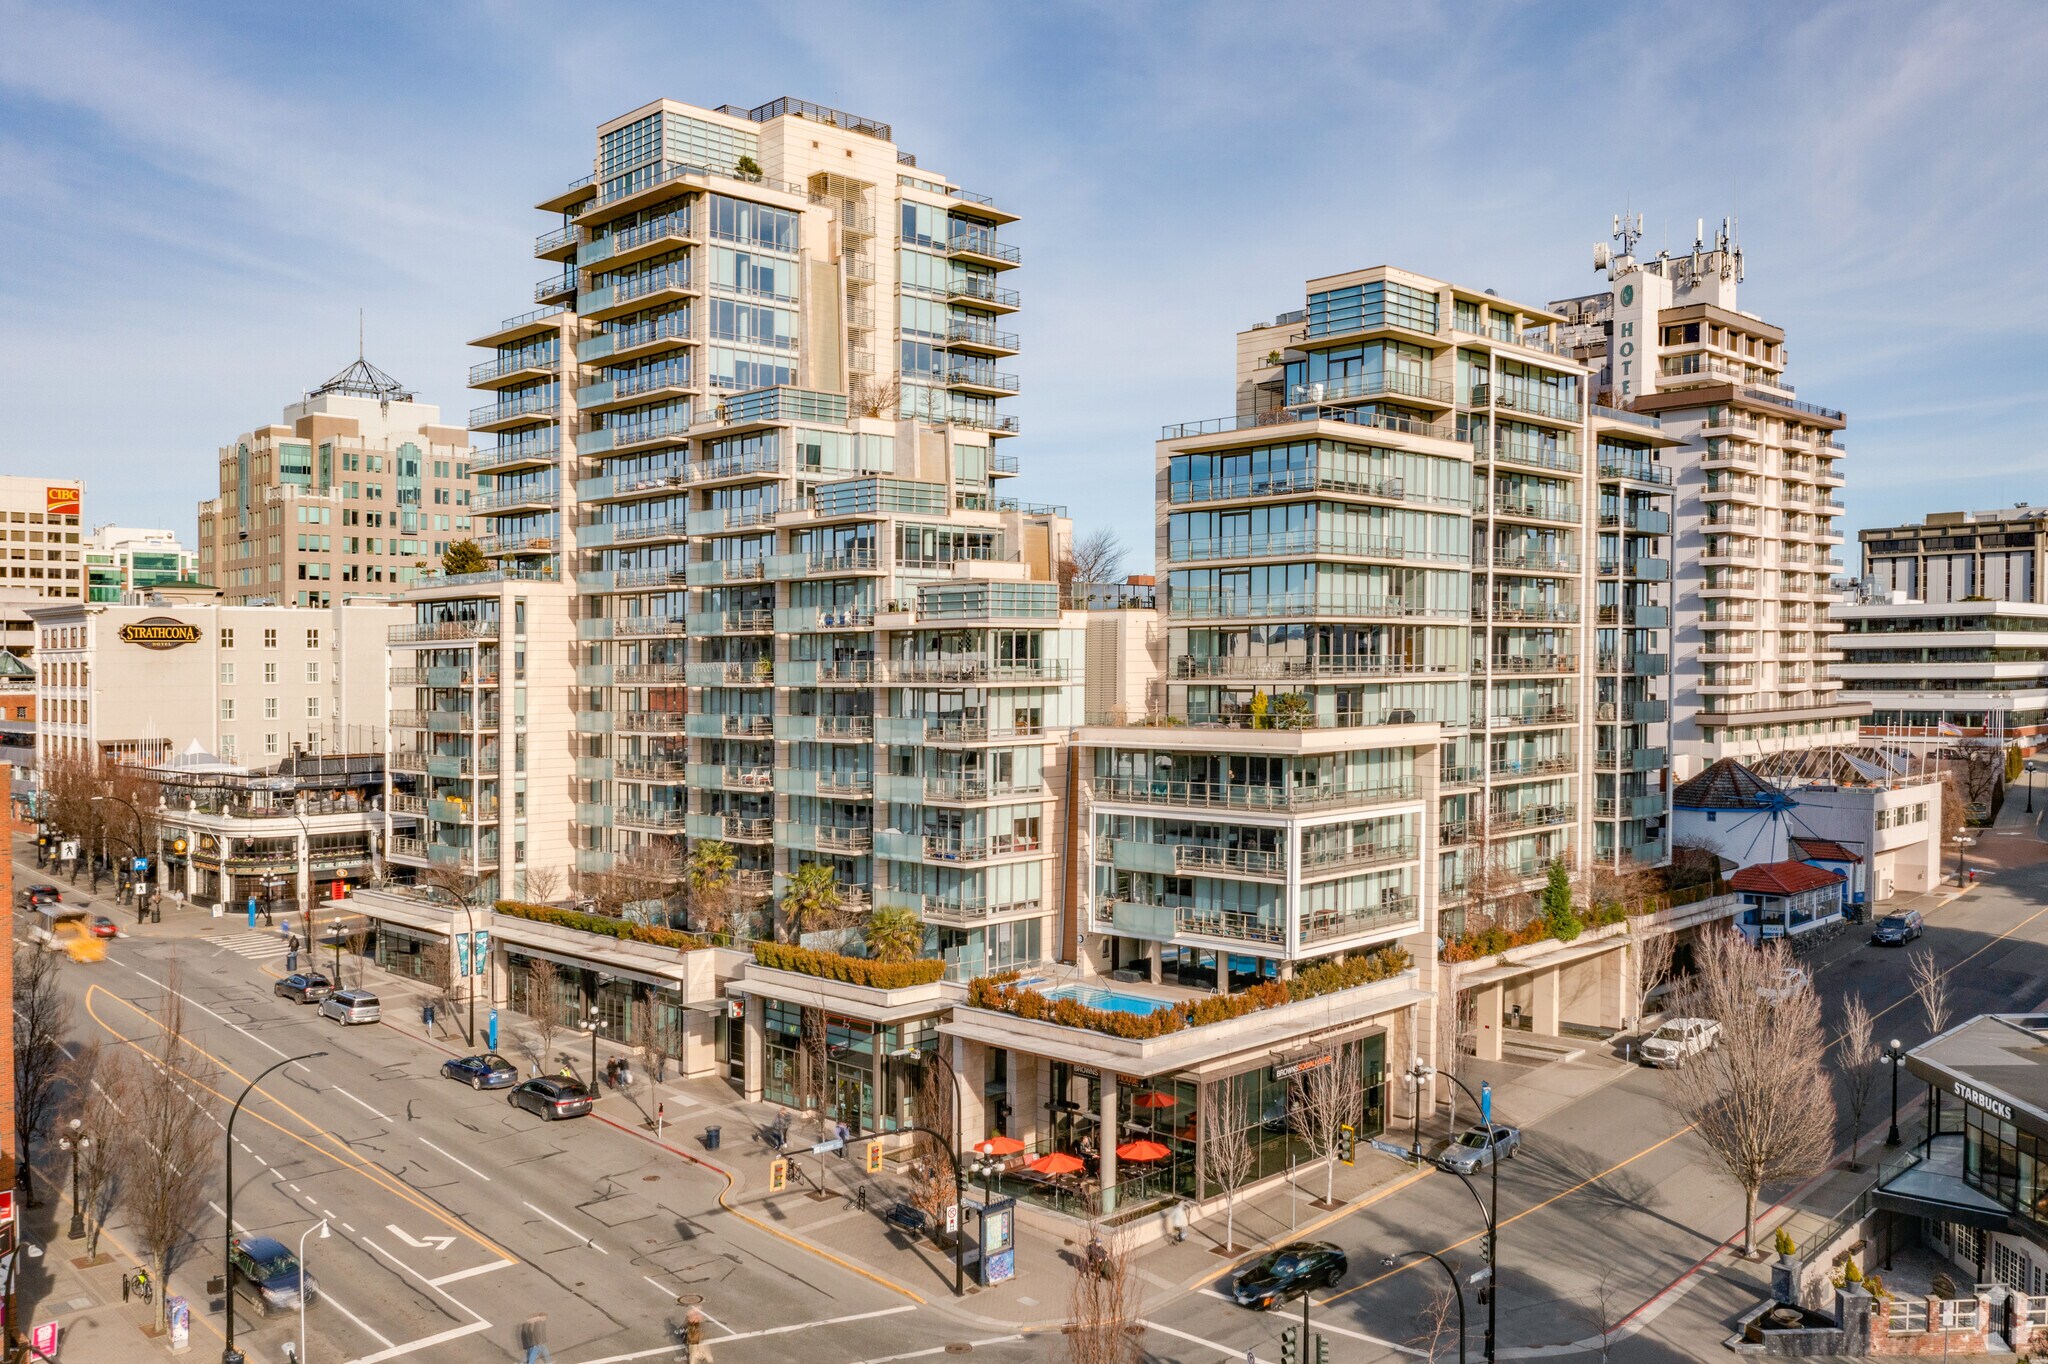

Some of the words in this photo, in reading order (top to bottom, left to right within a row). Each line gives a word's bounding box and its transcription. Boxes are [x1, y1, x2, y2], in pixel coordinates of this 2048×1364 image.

[48, 488, 79, 501] CIBC
[126, 625, 195, 640] STRATHCONA
[1073, 1064, 1099, 1077] BROWNS
[1954, 1081, 2012, 1120] STARBUCKS
